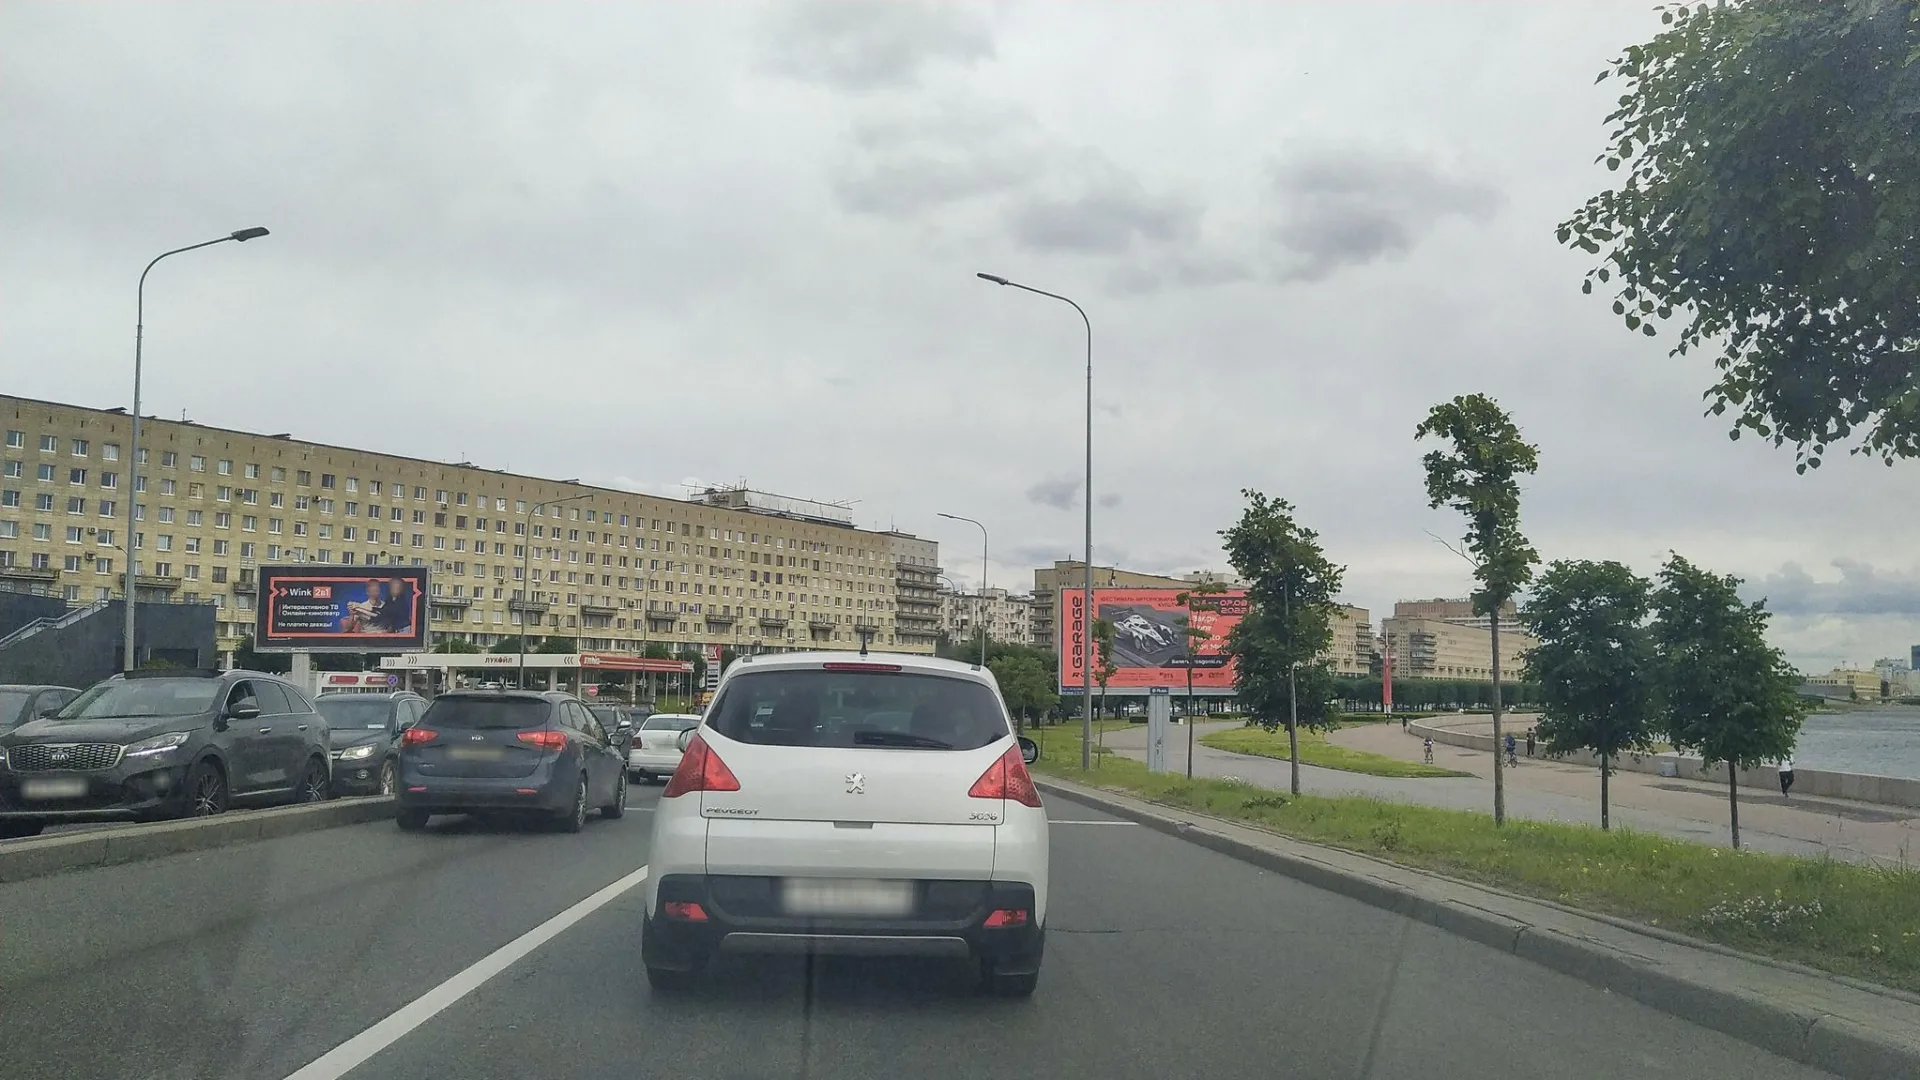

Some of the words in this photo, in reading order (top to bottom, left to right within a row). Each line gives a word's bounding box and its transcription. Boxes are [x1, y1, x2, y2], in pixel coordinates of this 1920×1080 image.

[289, 588, 312, 597] Wink
[315, 588, 329, 596] 2в1
[706, 807, 760, 815] PEUGEOT
[969, 812, 997, 821] 3008
